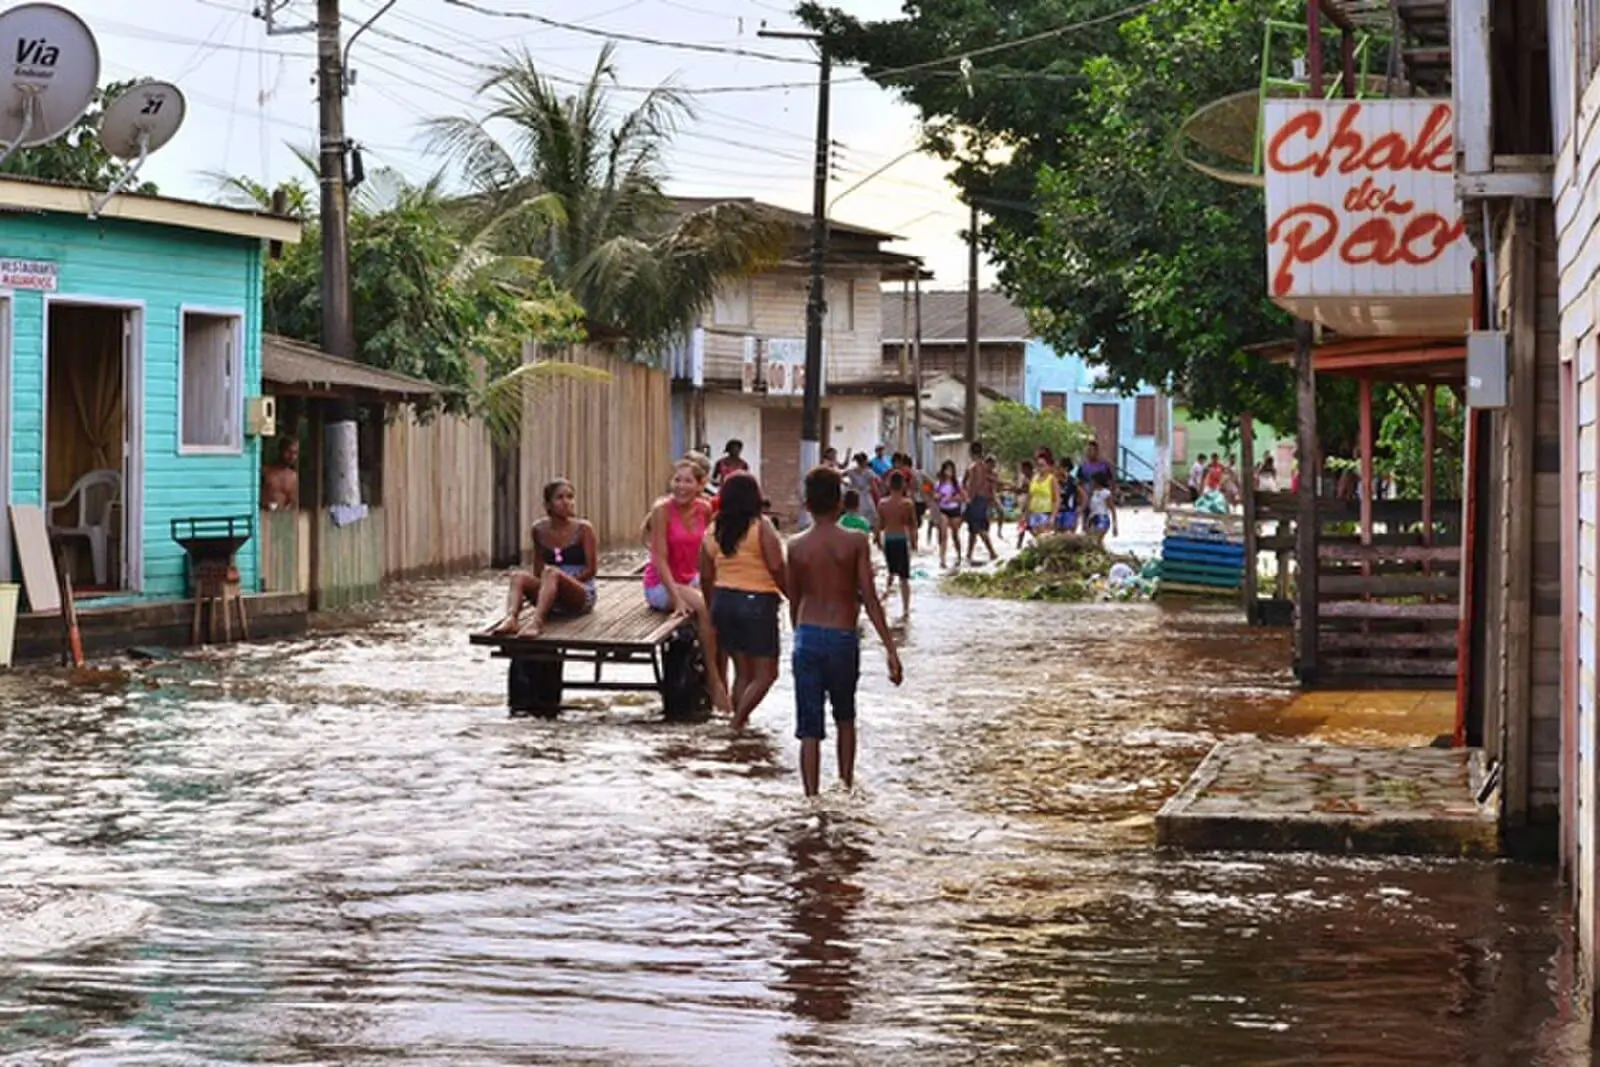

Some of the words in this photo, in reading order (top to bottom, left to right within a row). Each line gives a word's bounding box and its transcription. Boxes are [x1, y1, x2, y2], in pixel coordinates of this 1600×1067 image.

[16, 37, 60, 66] Via
[140, 99, 163, 115] 21
[1267, 200, 1466, 297] Pão
